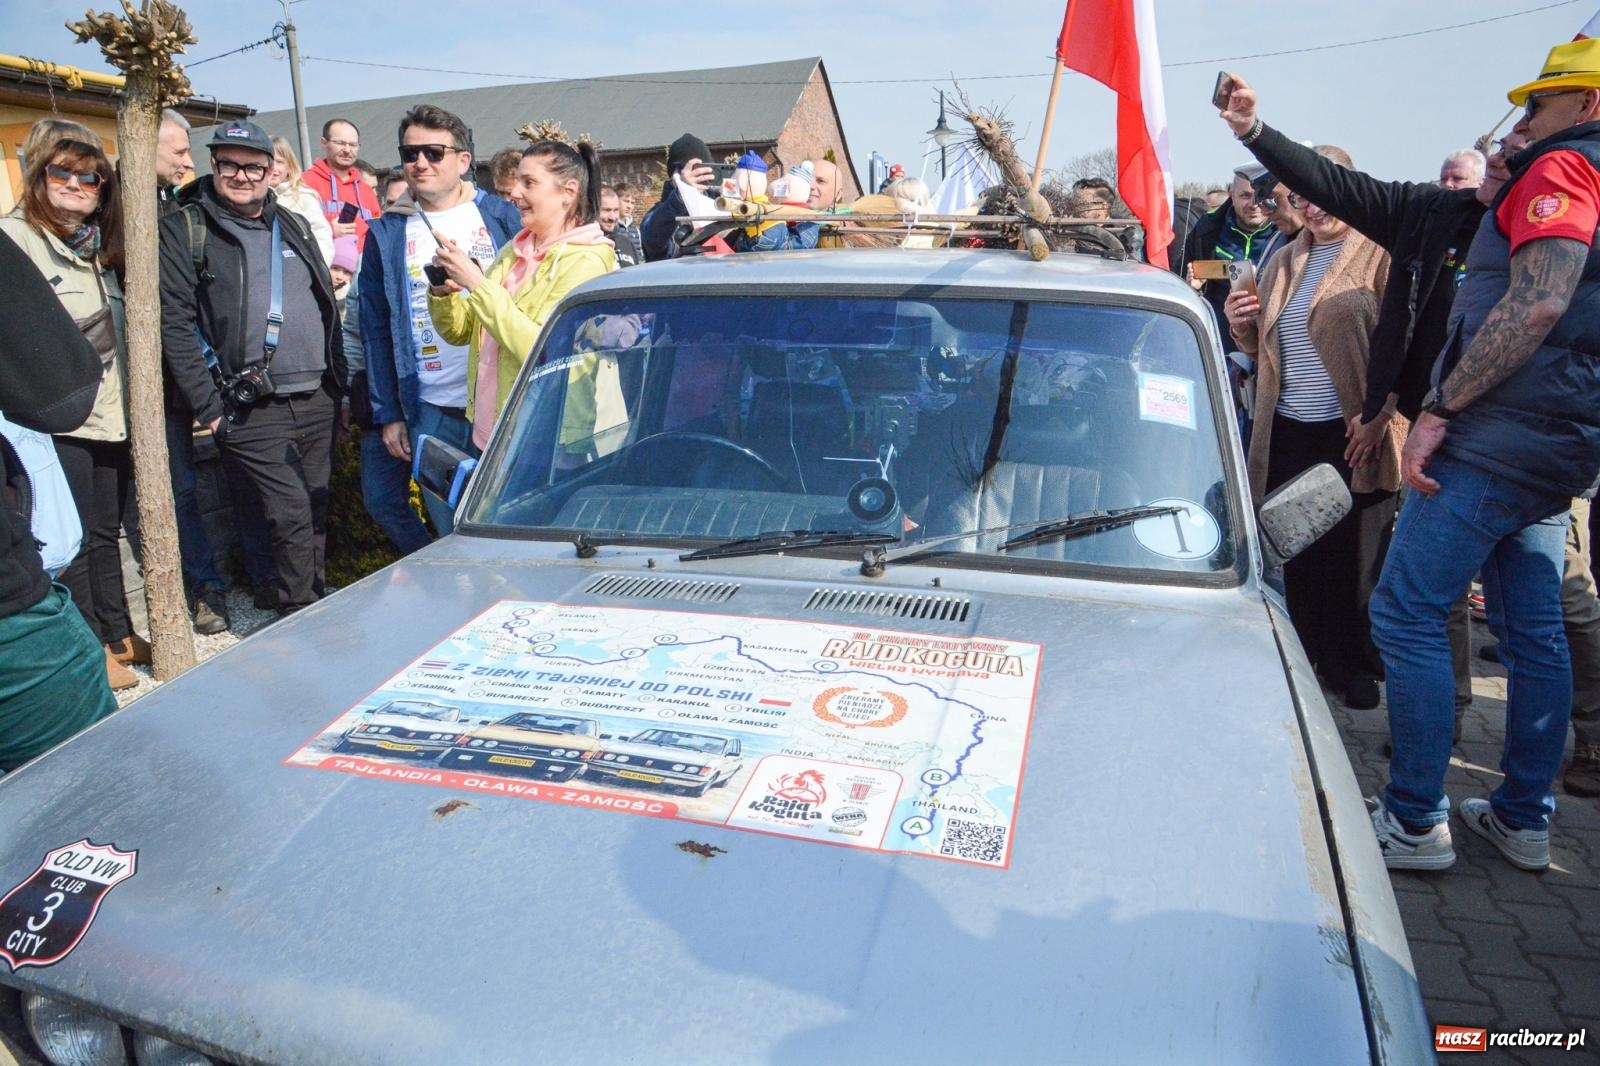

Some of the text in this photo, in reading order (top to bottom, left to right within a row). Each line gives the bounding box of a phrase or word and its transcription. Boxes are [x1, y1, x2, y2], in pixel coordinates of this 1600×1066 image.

[1163, 391, 1187, 405] 2569
[743, 644, 808, 654] KAZAKHSTAN
[821, 638, 1024, 677] RAJD KOGUTA
[703, 664, 766, 675] UZBEKISTAN
[452, 663, 470, 671] Z
[638, 681, 669, 692] DO
[673, 684, 753, 701] POLSKI
[664, 670, 744, 683] TURKMENISTAN
[486, 692, 549, 702] BUKARESZT
[841, 694, 885, 704] ZBIERAMY
[579, 701, 645, 713] BUDAPESZT
[745, 707, 786, 717] TBILISI
[841, 712, 870, 721] DZIECI
[970, 713, 1007, 722] CHINA
[780, 748, 814, 758] INDIA
[930, 773, 943, 781] B
[334, 759, 443, 782] TAJLANDIA
[463, 778, 539, 796] OŁAWA
[560, 791, 664, 814] ZAMOŚĆ
[763, 795, 811, 812] Rajd
[911, 800, 978, 815] THAILAND
[747, 800, 823, 821] Koguta
[909, 821, 923, 831] A
[53, 850, 126, 879] OLD VW
[50, 876, 87, 894] CLUB
[27, 891, 65, 932] 3
[6, 929, 47, 956] CITY
